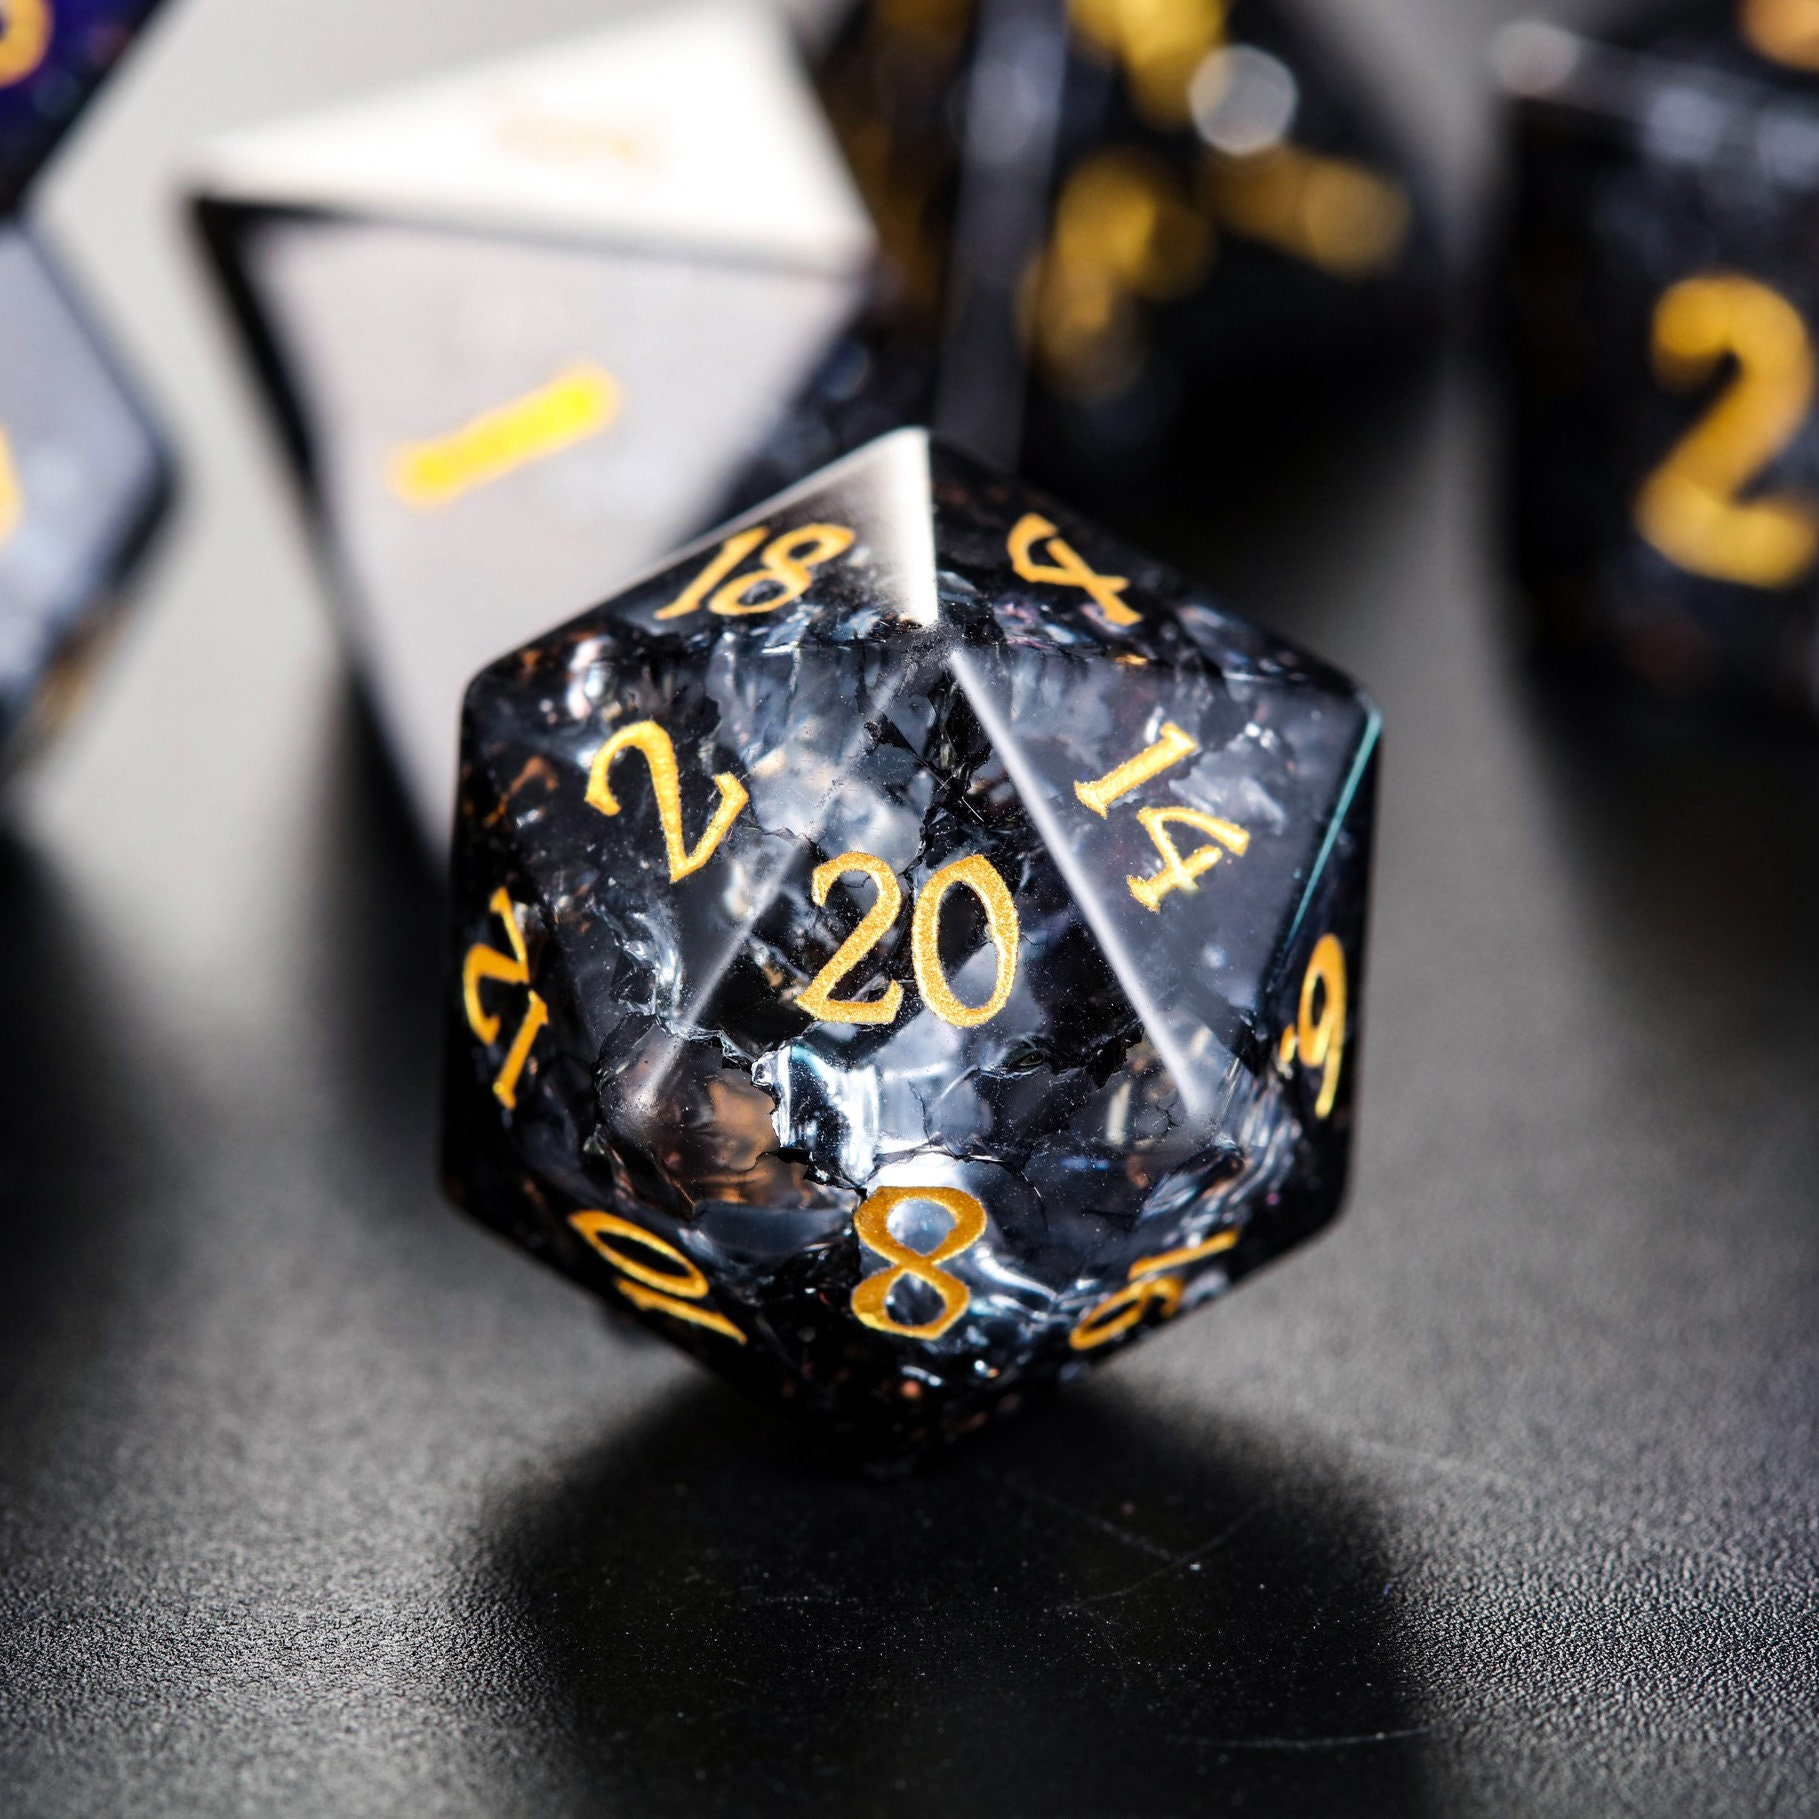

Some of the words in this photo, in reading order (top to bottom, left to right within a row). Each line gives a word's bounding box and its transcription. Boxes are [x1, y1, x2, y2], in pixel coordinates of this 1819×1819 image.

[1636, 272, 1816, 588] 2
[653, 523, 856, 620] 18
[1007, 514, 1139, 625] 4
[584, 720, 749, 882] 2
[1073, 721, 1250, 915] 14
[463, 887, 549, 1110] 12
[796, 851, 1018, 1027] 20
[568, 1210, 747, 1345] 10
[852, 1186, 987, 1340] 8
[1068, 1227, 1240, 1350] 16
